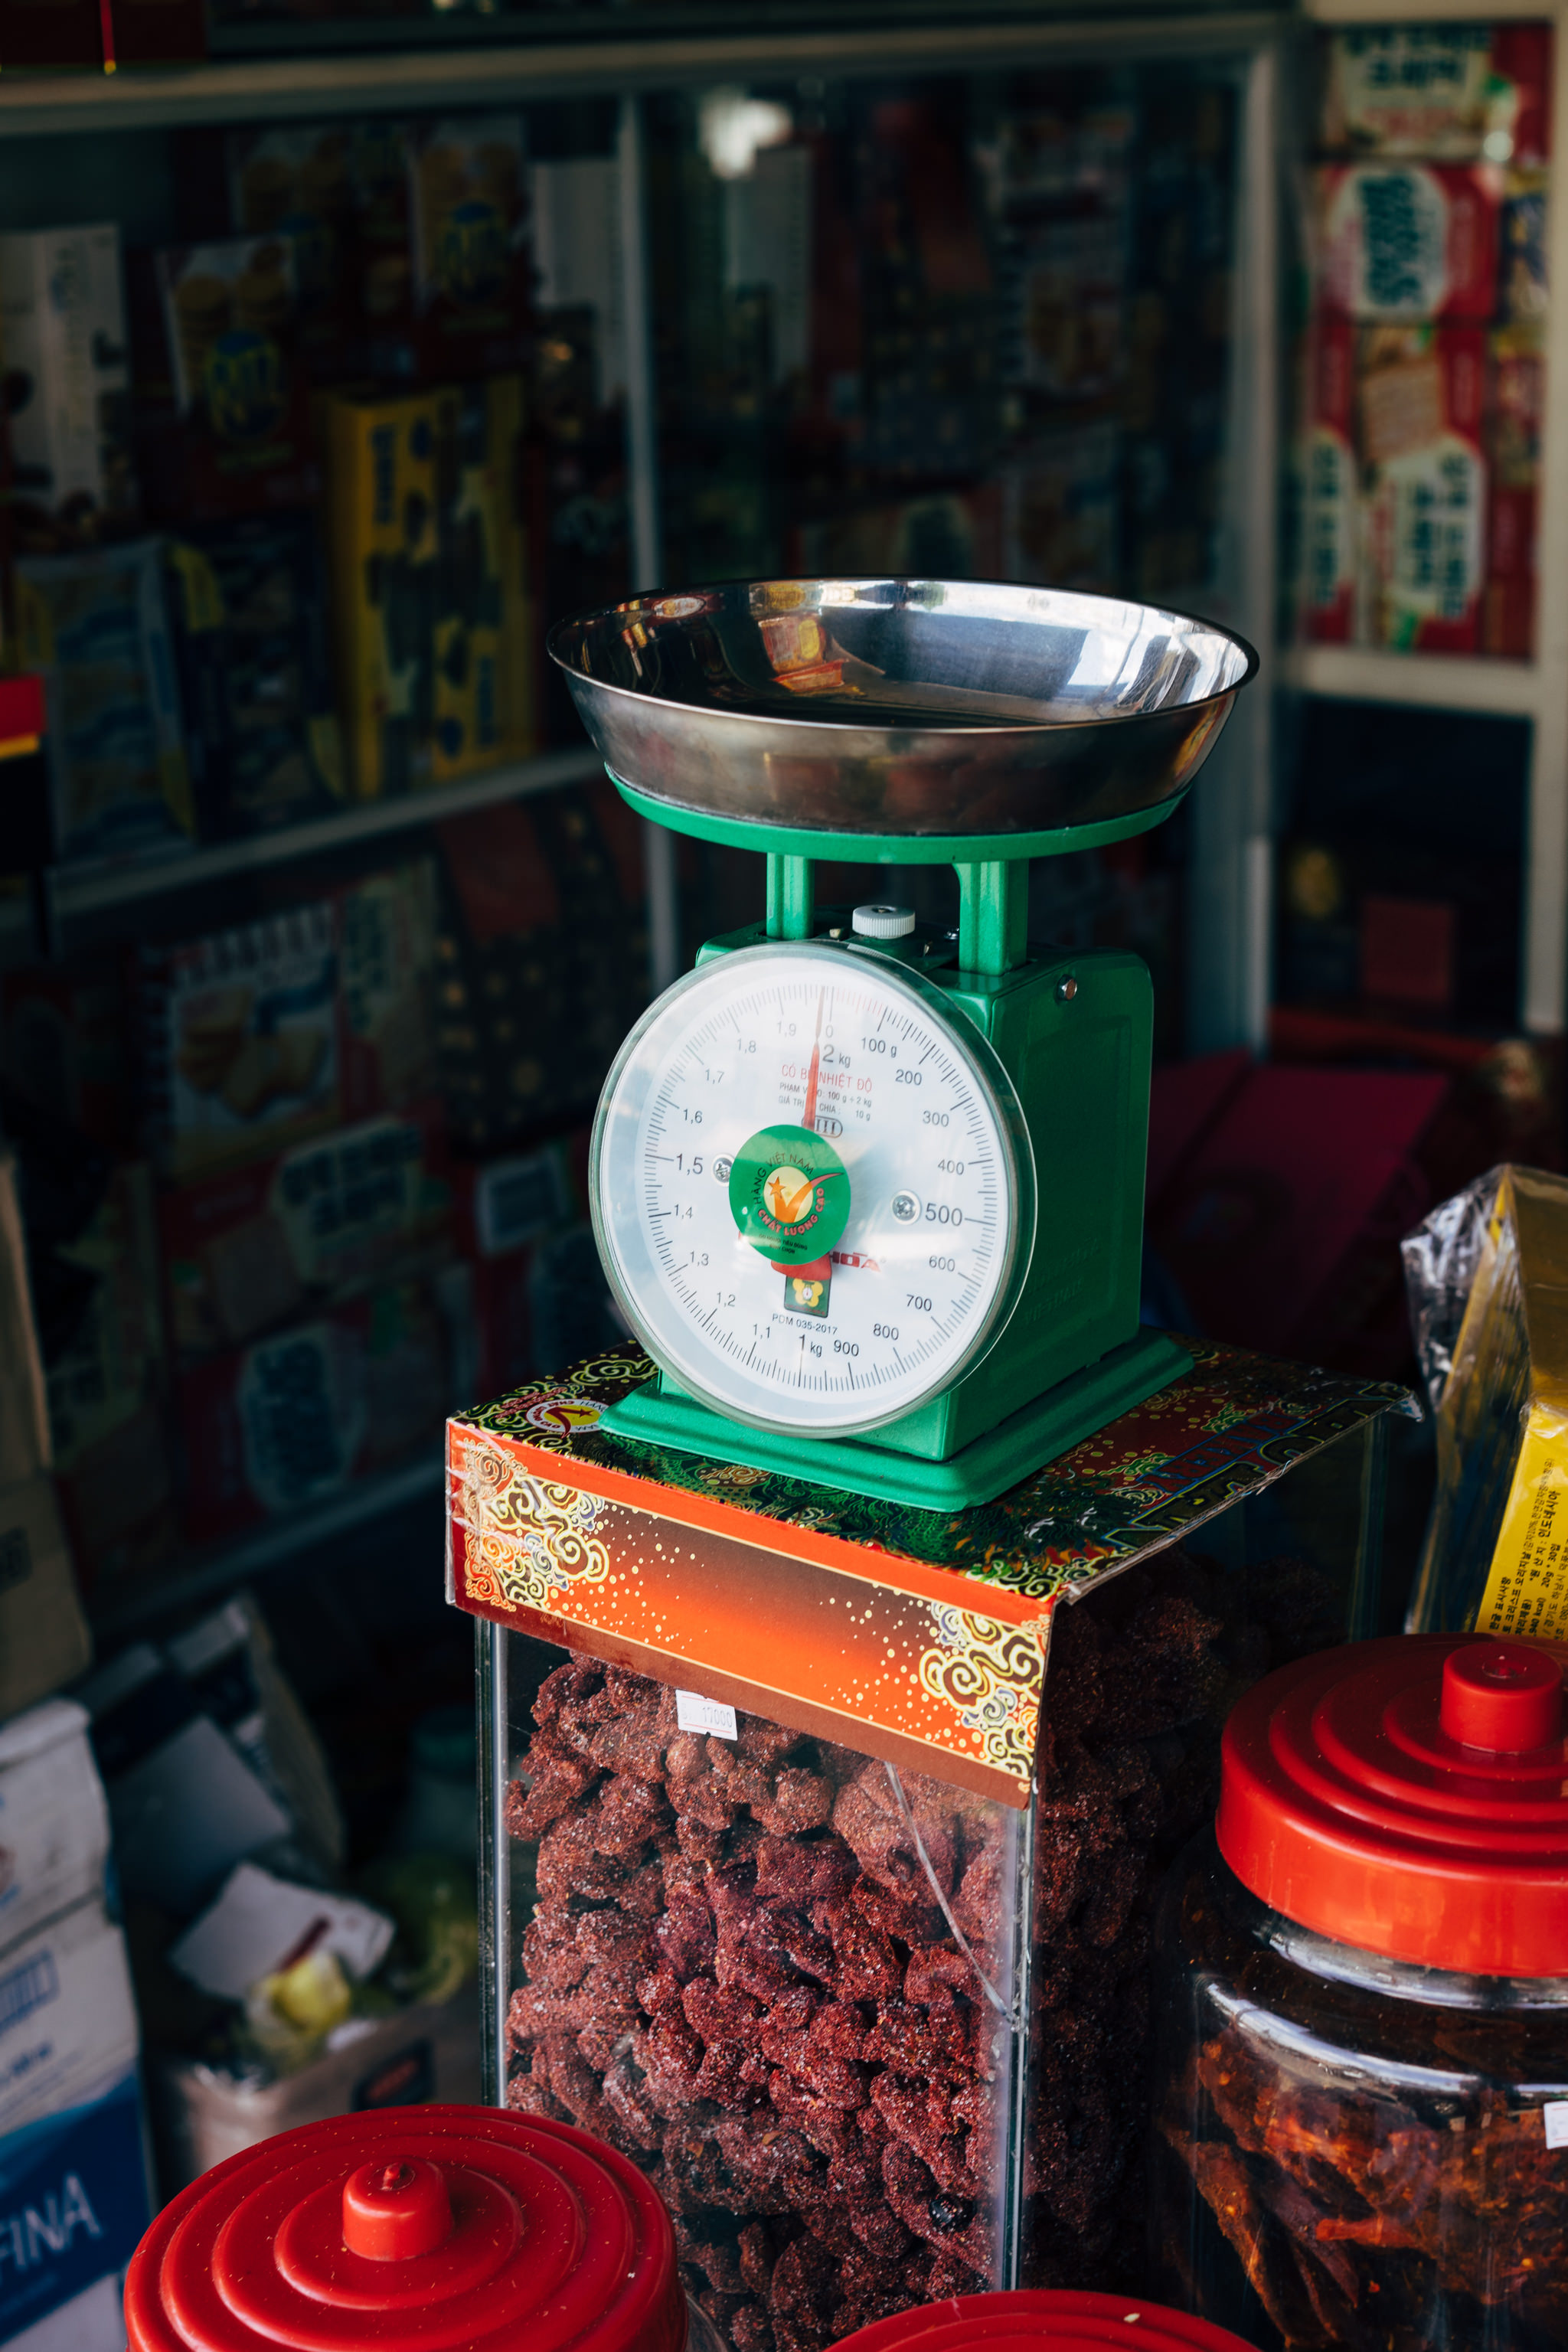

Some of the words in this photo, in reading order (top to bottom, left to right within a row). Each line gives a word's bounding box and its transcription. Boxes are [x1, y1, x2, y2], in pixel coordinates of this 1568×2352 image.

[776, 1021, 797, 1037] 1,9
[825, 1024, 835, 1039] 0
[737, 1037, 757, 1054] 1,8
[861, 1036, 887, 1054] 100
[890, 1045, 898, 1059] g
[822, 1044, 835, 1063] 2
[838, 1052, 851, 1069] kg
[704, 1068, 725, 1085] 1,7
[781, 1063, 797, 1079] CÓ
[818, 1071, 853, 1089] NHIỆT
[857, 1076, 873, 1094] ĐỘ
[895, 1068, 923, 1086] 200
[828, 1090, 841, 1101] 100
[863, 1097, 873, 1109] kg
[682, 1108, 703, 1125] 1,6
[922, 1109, 949, 1128] 300
[676, 1152, 704, 1176] 1,5
[937, 1158, 965, 1176] 400
[751, 1167, 766, 1205] HÀNG
[789, 1154, 815, 1175] NAM
[674, 1204, 694, 1220] 1,4
[758, 1209, 782, 1234] CHẤT
[815, 1187, 825, 1213] CAO
[924, 1202, 963, 1227] 500
[689, 1250, 710, 1267] 1,3
[928, 1255, 956, 1272] 600
[716, 1291, 737, 1308] 1,2
[906, 1293, 933, 1312] 700
[753, 1323, 771, 1340] 1,1
[772, 1313, 793, 1326] PDM
[795, 1318, 838, 1335] 035-2017
[872, 1323, 900, 1341] 800
[809, 1341, 823, 1358] kg
[833, 1339, 860, 1357] 900
[1537, 1490, 1561, 1538] 인도네시아
[1504, 1589, 1521, 1623] 크리스프
[1515, 1551, 1532, 1586] 오리지날
[1540, 1571, 1554, 1588] 20g
[703, 1707, 733, 1728] 17000
